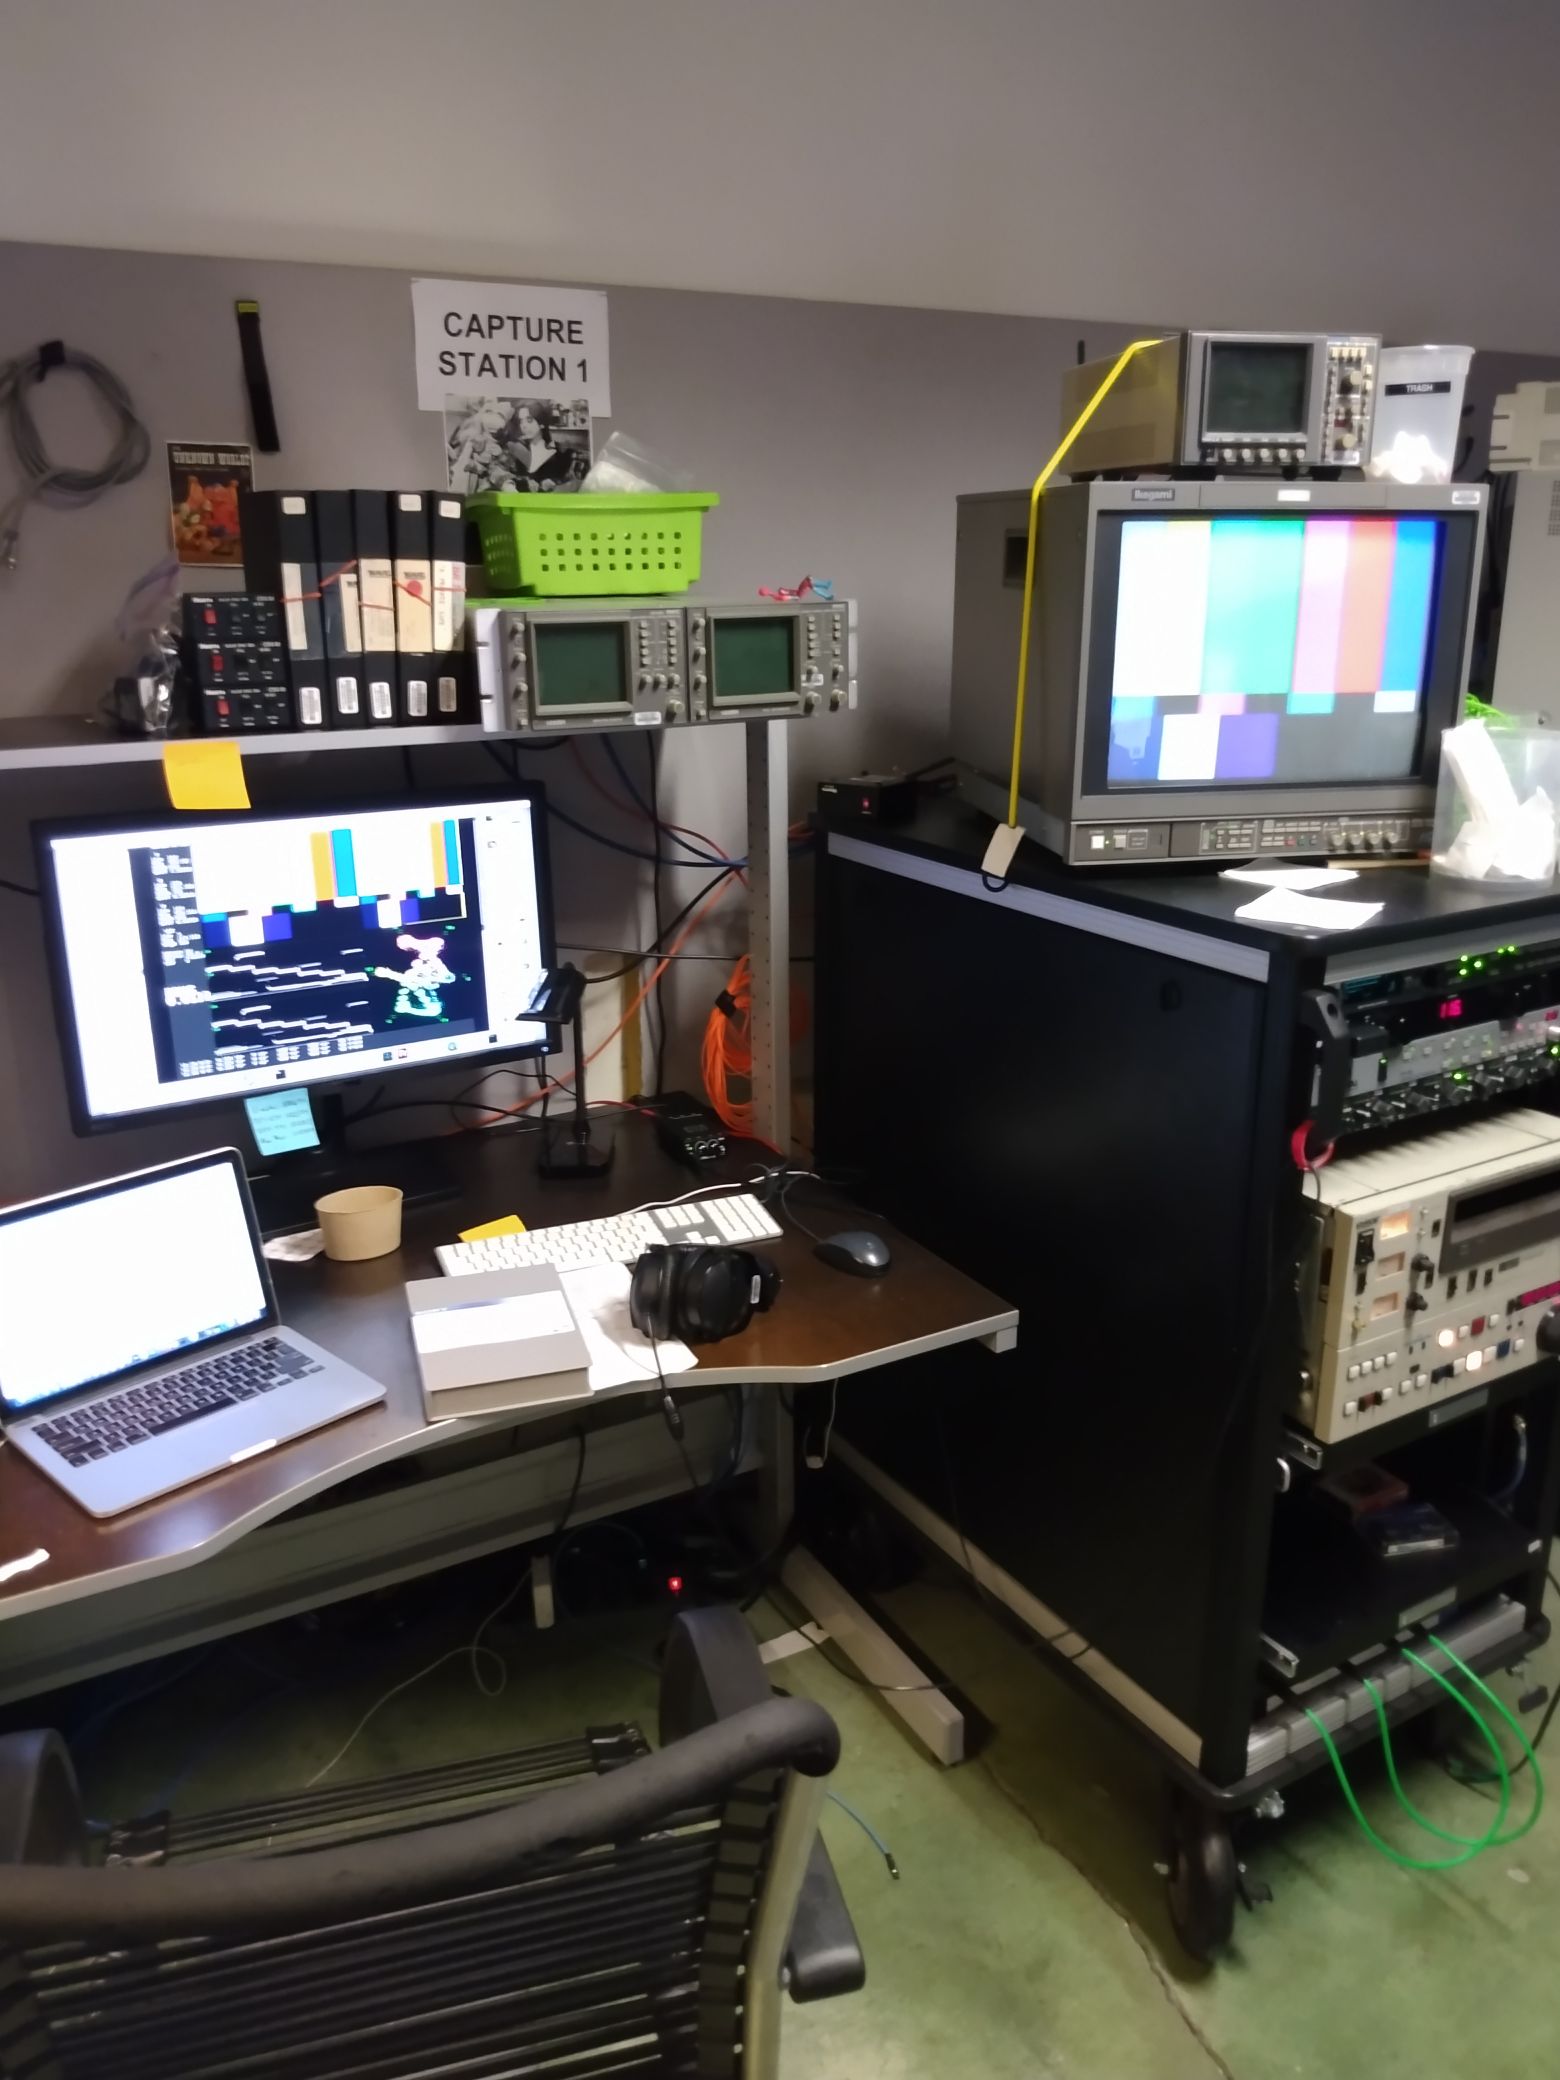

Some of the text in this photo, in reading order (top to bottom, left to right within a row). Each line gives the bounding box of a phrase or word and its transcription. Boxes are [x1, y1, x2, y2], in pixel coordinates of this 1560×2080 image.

[444, 311, 583, 345] CAPTURE
[438, 350, 588, 383] STATION 1
